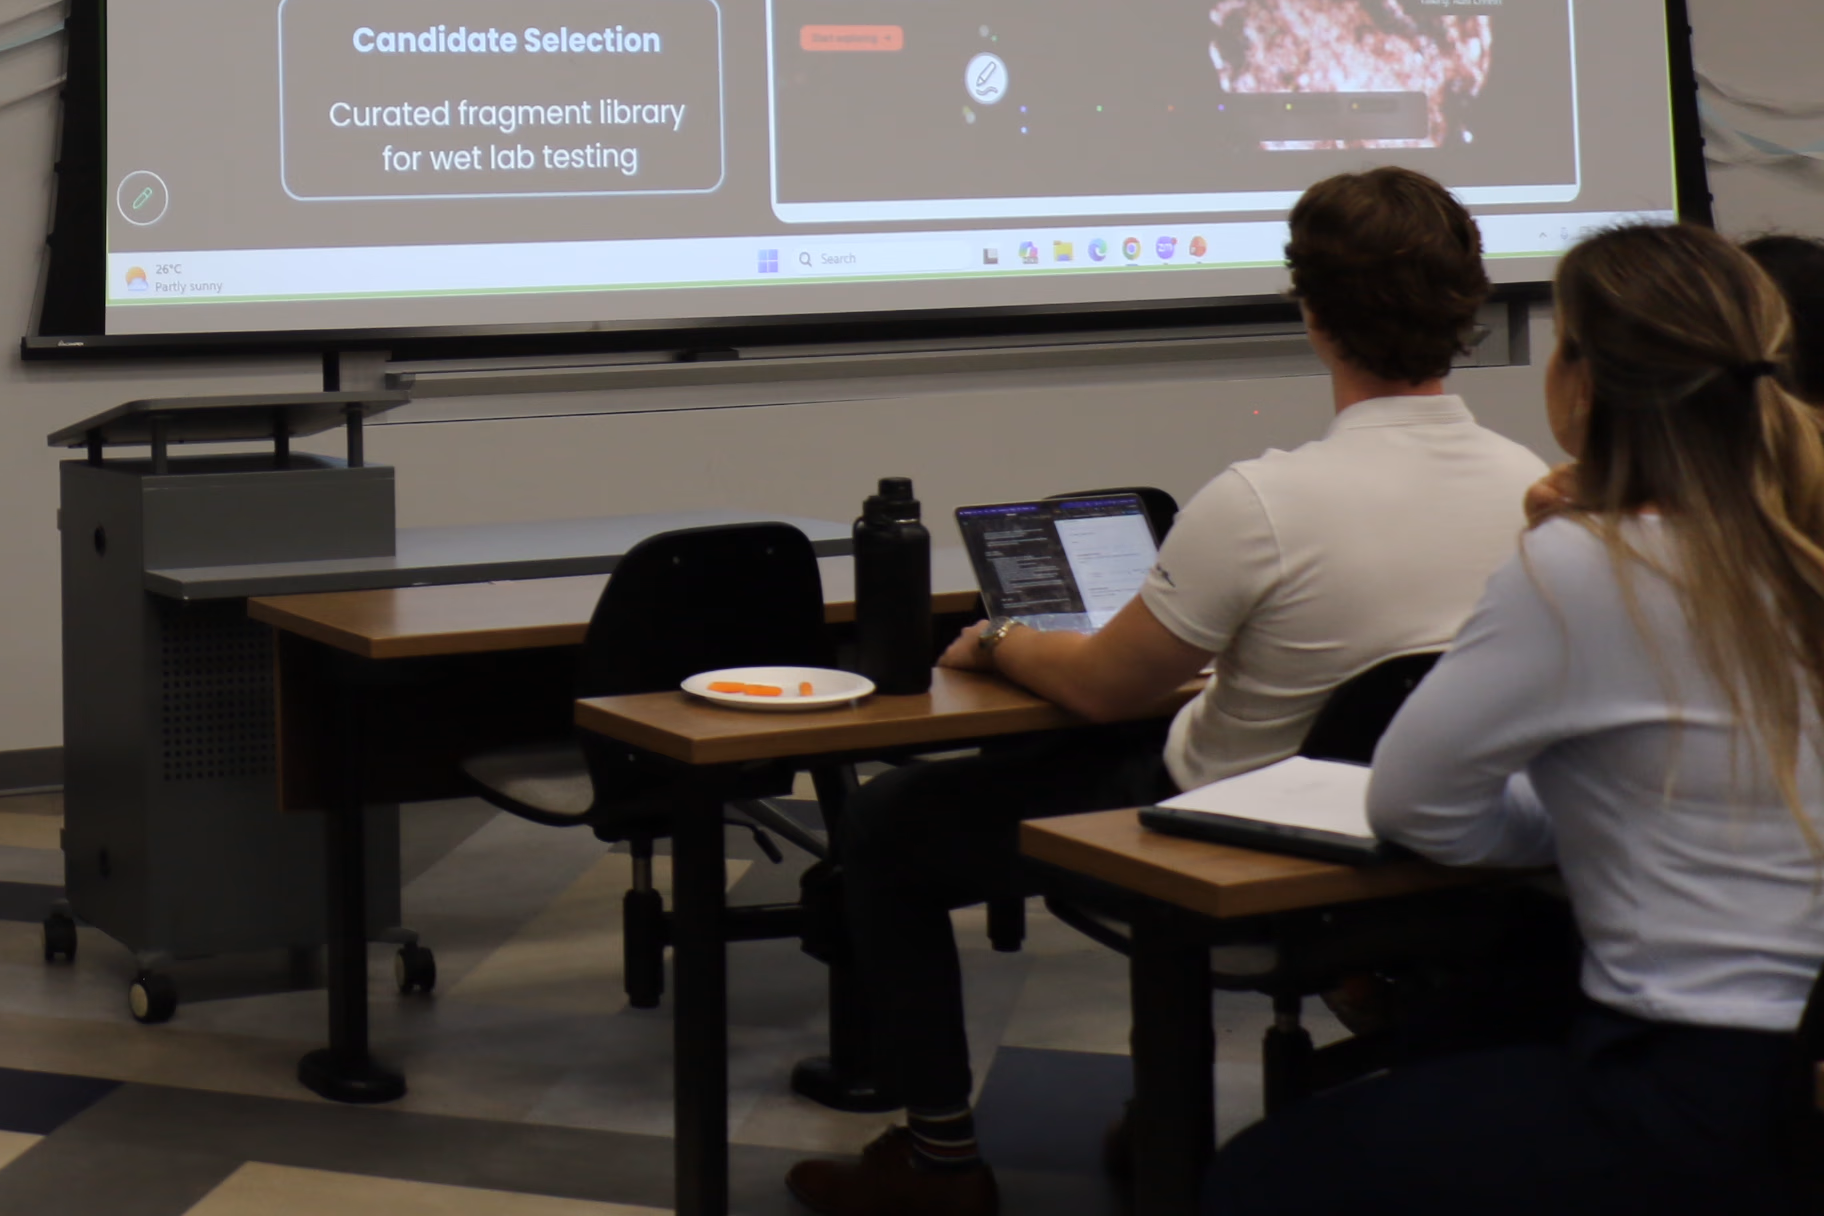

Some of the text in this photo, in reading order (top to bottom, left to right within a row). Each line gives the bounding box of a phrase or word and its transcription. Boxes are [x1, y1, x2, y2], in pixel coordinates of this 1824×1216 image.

[352, 24, 662, 54] Candidate Selection
[328, 97, 686, 133] Curated fragment library
[381, 142, 639, 176] for wet lab testing
[155, 263, 182, 275] 26°C
[820, 250, 857, 266] Search
[155, 281, 223, 293] Partly sunny
